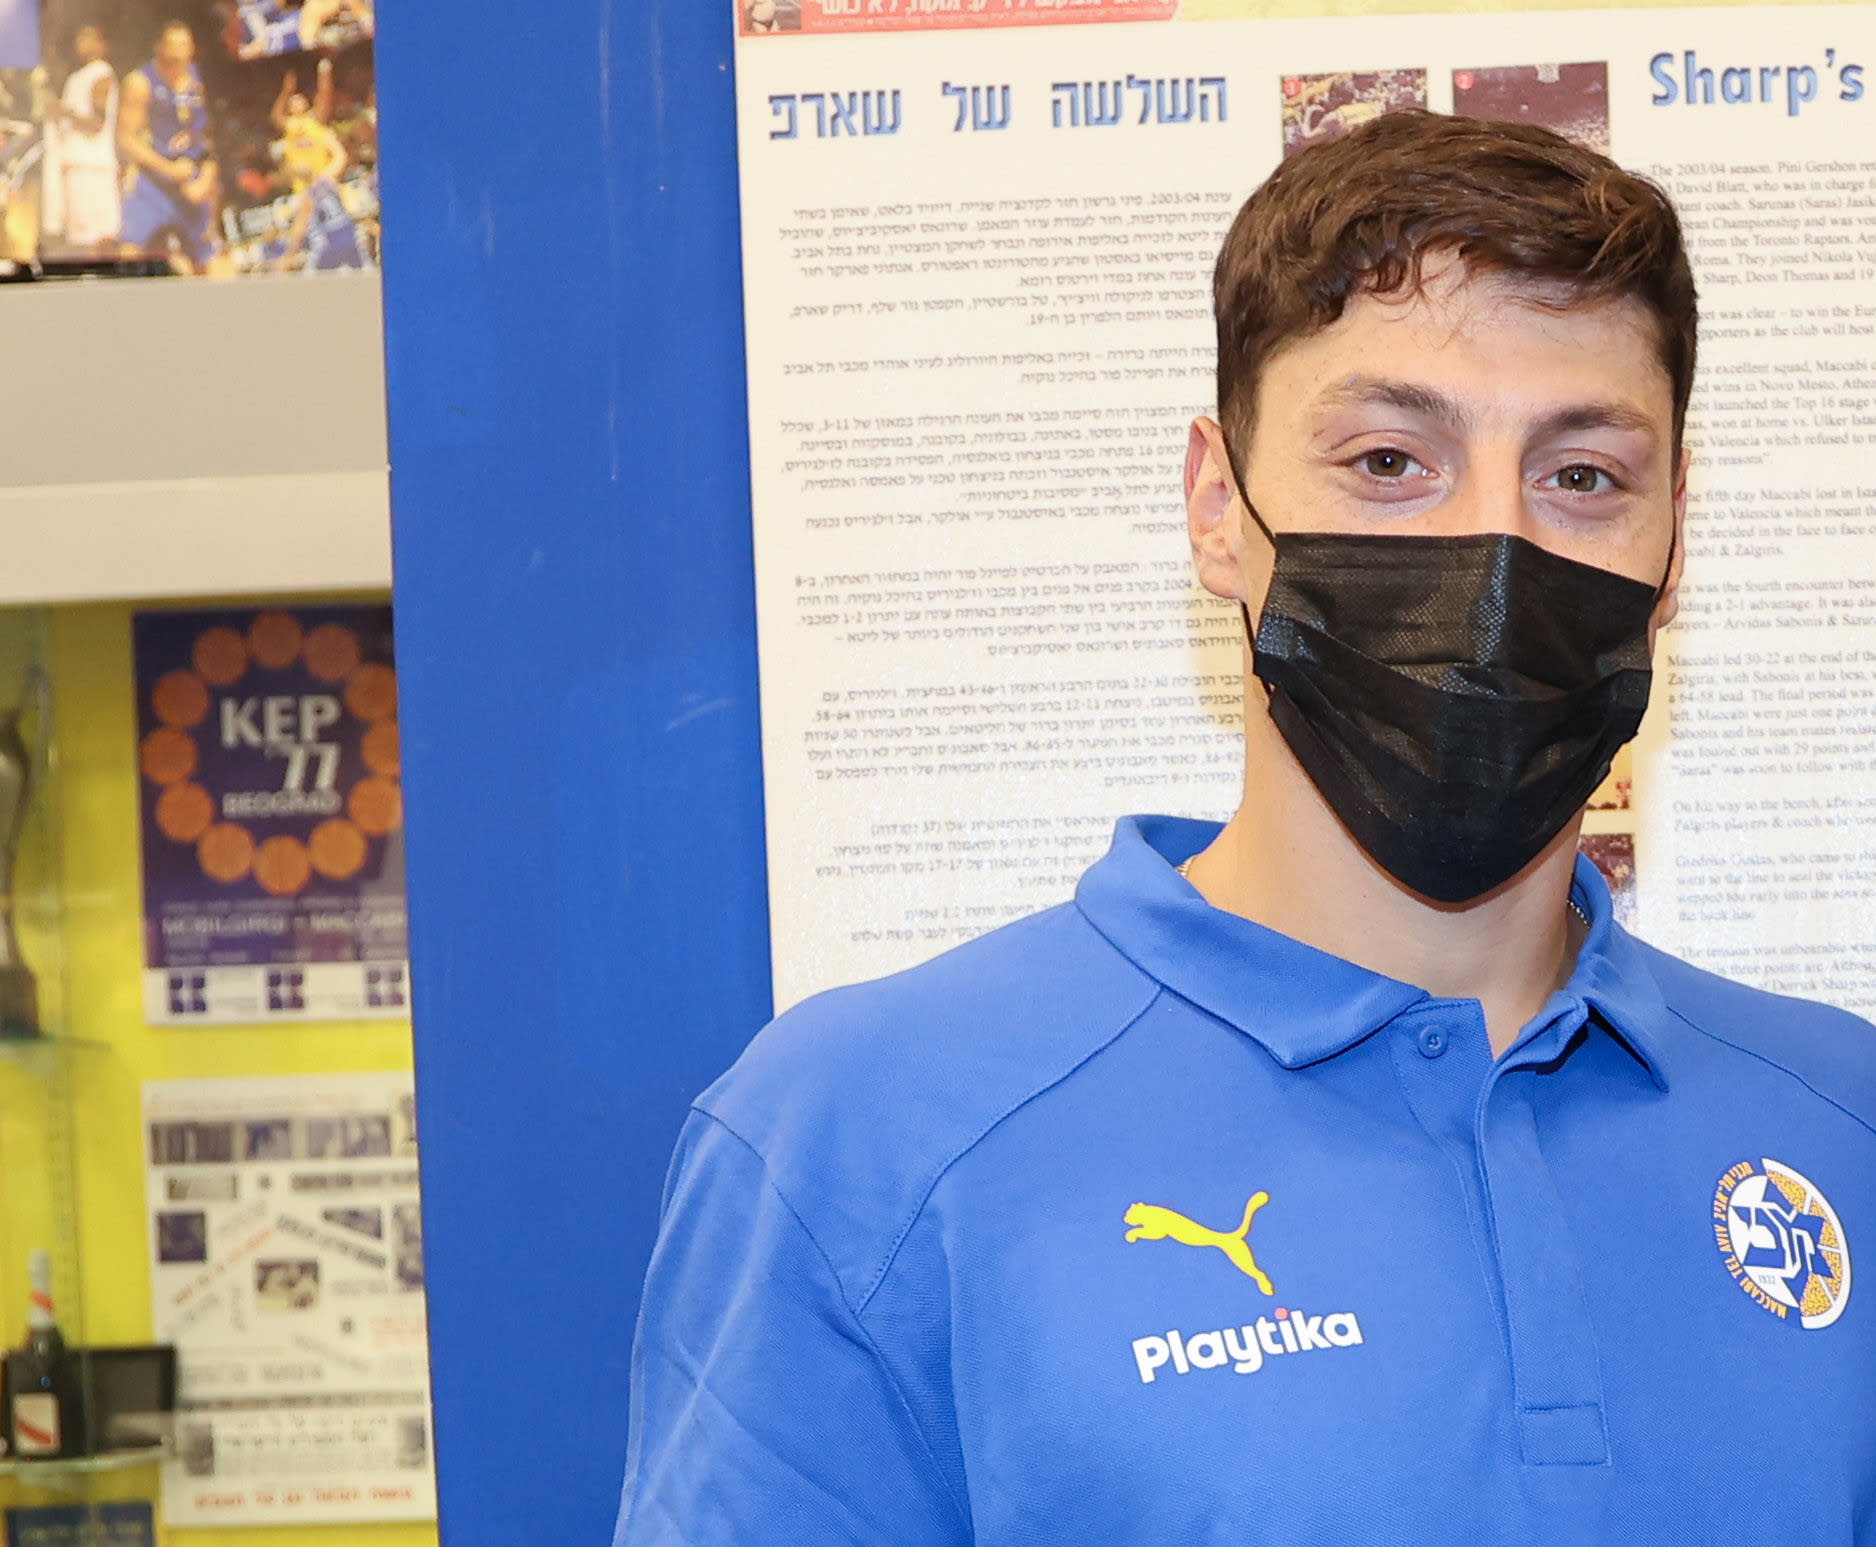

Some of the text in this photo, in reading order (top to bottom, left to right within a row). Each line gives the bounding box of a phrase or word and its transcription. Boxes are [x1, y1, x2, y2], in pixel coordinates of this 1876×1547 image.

[1648, 49, 1864, 117] Sharp's
[768, 74, 1228, 141] השלשה של שארפ
[1650, 164, 1674, 176] The
[1776, 161, 1802, 173] Pini
[1804, 160, 1857, 173] Gershon
[1751, 180, 1780, 192] who
[1782, 182, 1807, 191] was
[1808, 179, 1822, 191] in
[1824, 178, 1866, 193] charge
[1711, 215, 1801, 232] Championship
[1802, 215, 1827, 227] and
[1829, 217, 1853, 226] was
[1696, 236, 1727, 248] from
[1729, 235, 1750, 247] the
[1752, 234, 1800, 247] Toronto
[1736, 252, 1766, 267] They
[1770, 252, 1809, 267] joined
[1743, 270, 1778, 282] Deon
[1782, 269, 1830, 282] Thomas
[1832, 269, 1856, 281] and
[1859, 268, 1874, 280] 19
[220, 695, 341, 750] KEP
[1714, 1224, 1788, 1319] MACCABI TEL AVIV
[1131, 1307, 1364, 1384] Playtika
